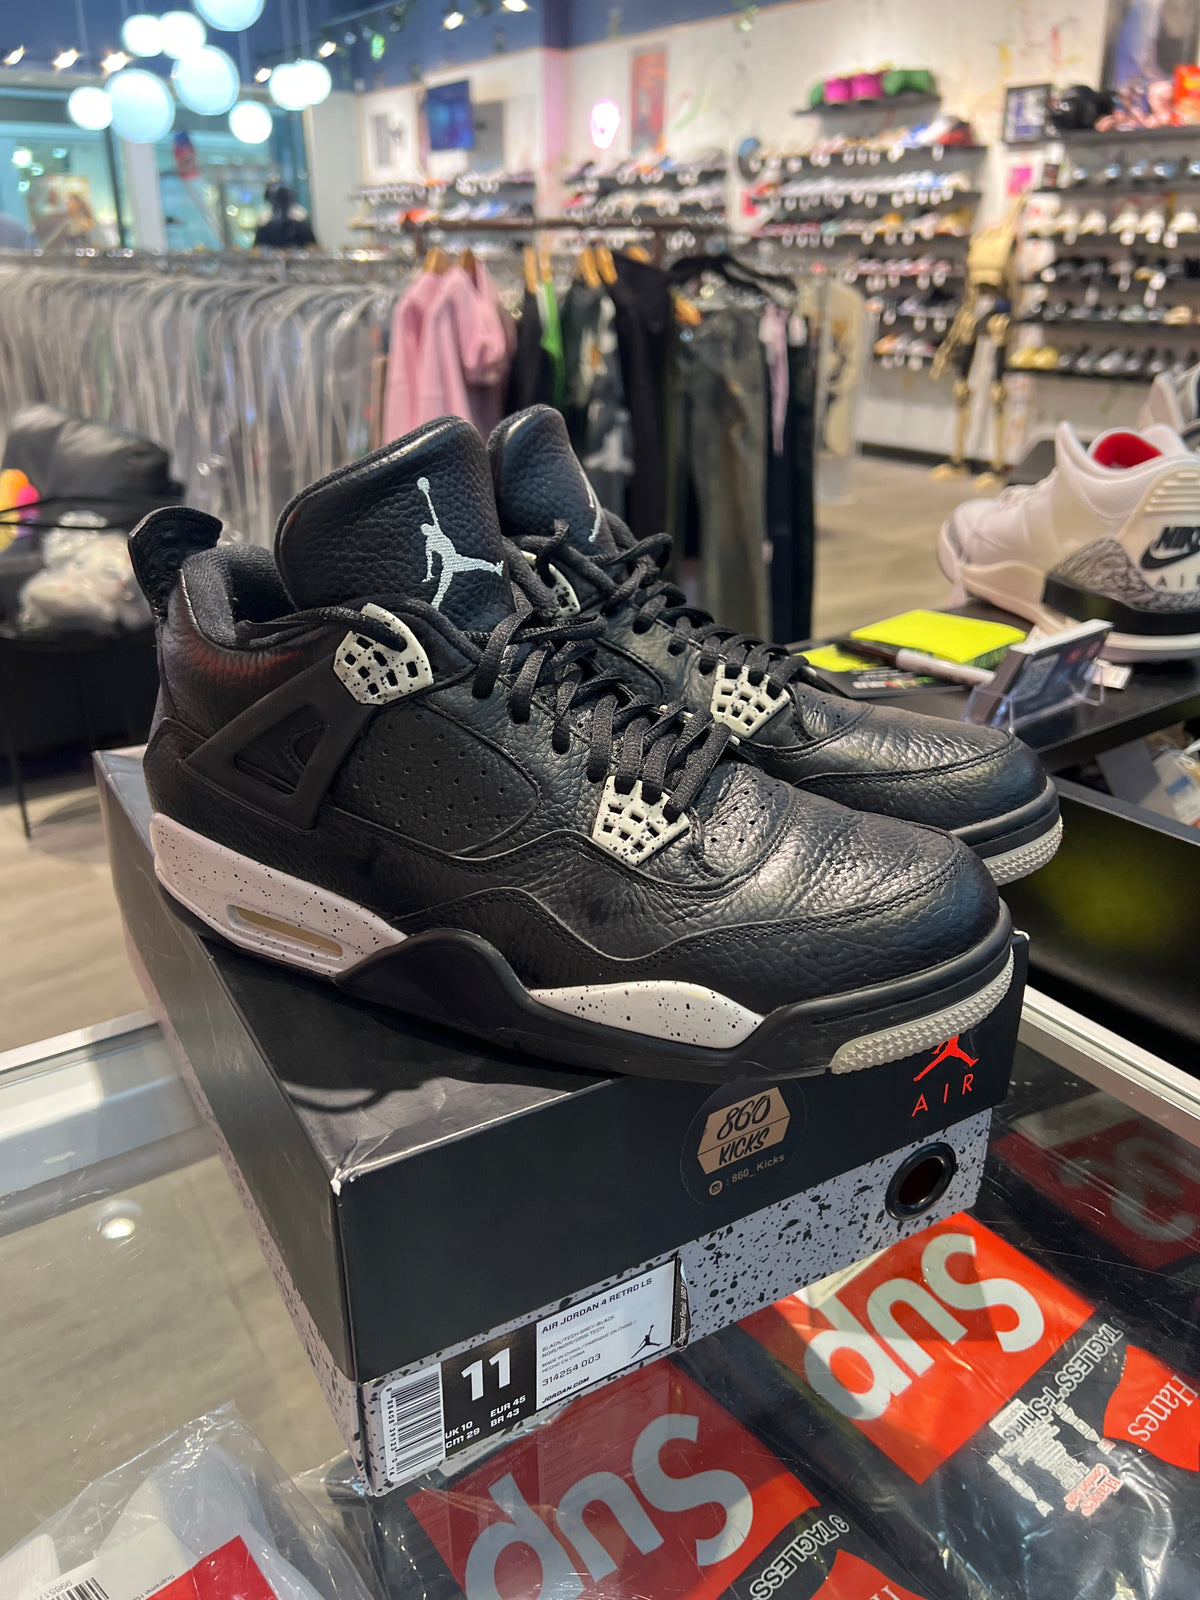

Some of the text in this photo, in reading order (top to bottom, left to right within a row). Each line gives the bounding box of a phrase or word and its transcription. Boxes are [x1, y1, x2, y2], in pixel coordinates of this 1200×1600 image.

[912, 1073, 974, 1117] AIR
[717, 1095, 771, 1140] 860
[719, 1127, 770, 1166] KICKS
[541, 1321, 559, 1334] AIR
[560, 1302, 599, 1325] JORDAN
[609, 1283, 640, 1302] RETRO
[641, 1277, 653, 1288] LS
[461, 1347, 511, 1401] 11
[542, 1358, 557, 1368] MADE
[542, 1353, 601, 1387] 314254 003
[490, 1395, 526, 1418] EUR 45
[542, 1376, 589, 1404] JORDAN.COM
[1128, 1375, 1200, 1442] Hanes
[445, 1420, 474, 1439] UK 10
[490, 1408, 520, 1428] BR 43
[1003, 1386, 1063, 1443] T-Shirts
[466, 1413, 754, 1600] Sup
[829, 1514, 849, 1533] 3
